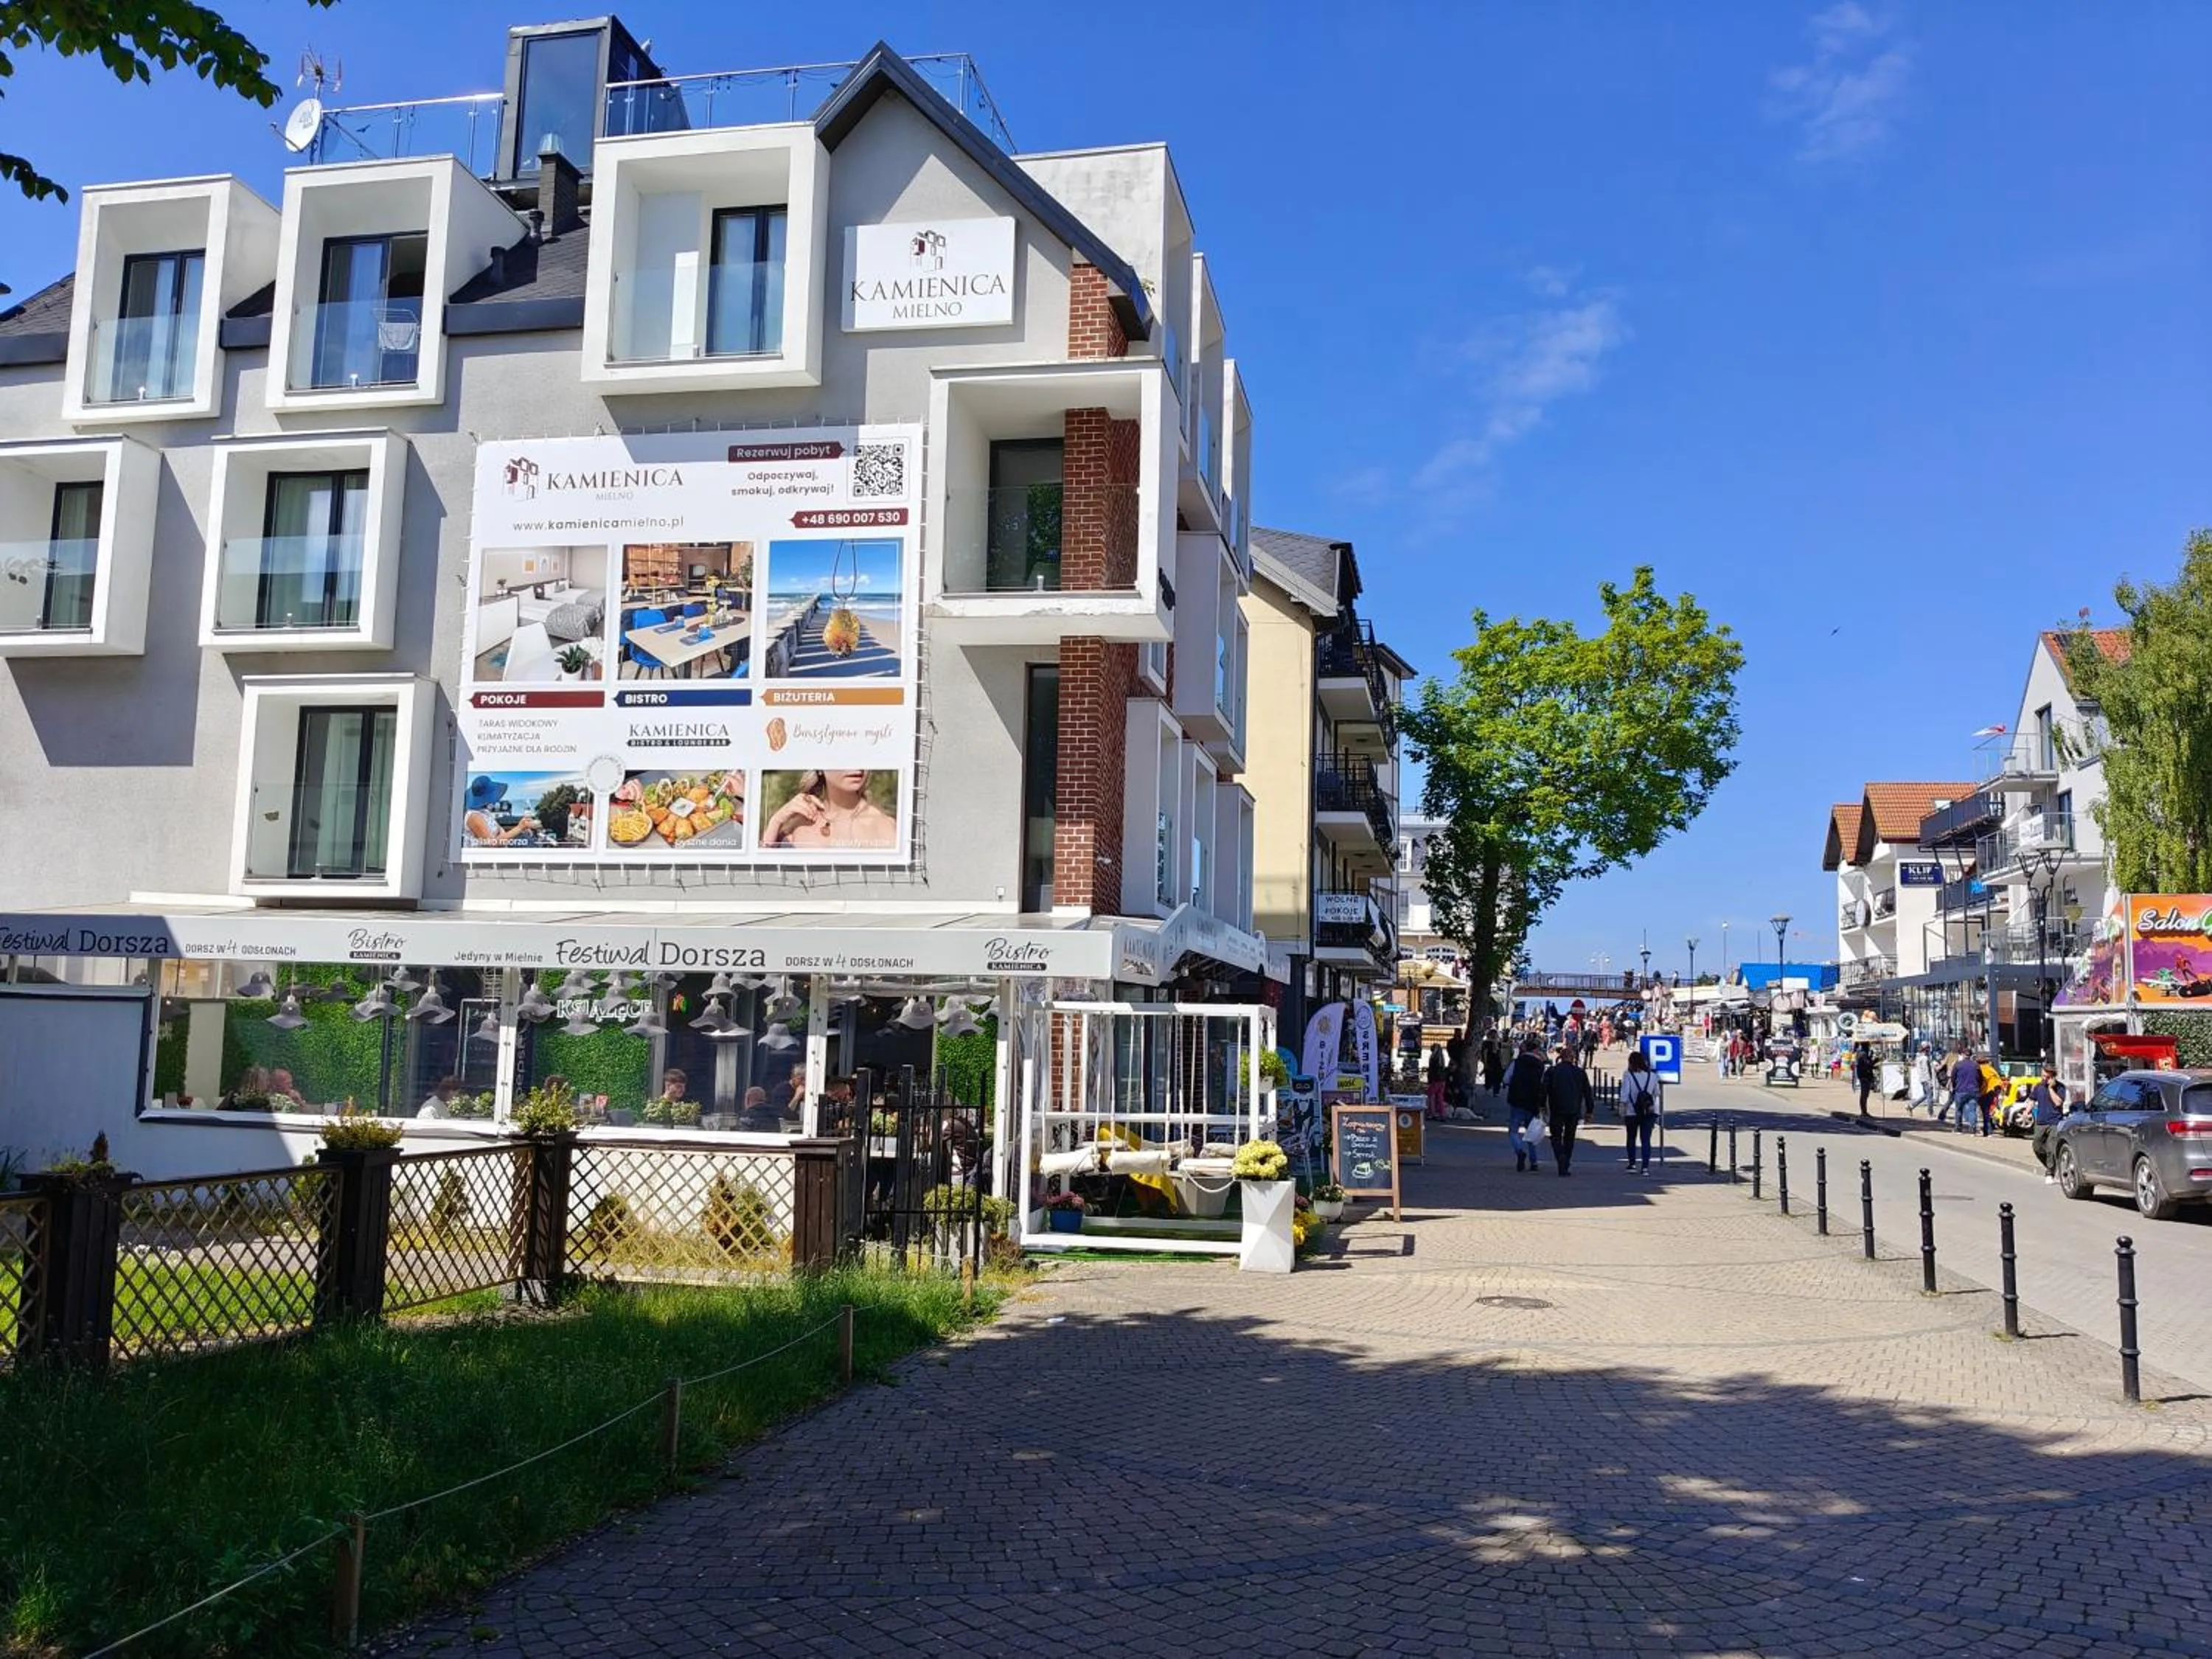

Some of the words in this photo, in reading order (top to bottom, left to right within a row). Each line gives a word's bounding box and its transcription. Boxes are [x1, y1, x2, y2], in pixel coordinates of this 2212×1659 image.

[850, 274, 1006, 302] KAMIENICA
[893, 301, 962, 319] MIELNO
[737, 448, 791, 459] Rezerwuj
[794, 445, 831, 458] pobyt
[548, 468, 684, 490] KAMIENICA
[748, 470, 818, 482] Odpoczywaj,
[595, 492, 633, 501] MIELNO
[731, 486, 775, 497] smokuj,
[778, 484, 834, 496] odkrywaj!
[513, 515, 684, 531] www.kamienicamielno.pl
[801, 514, 824, 524] +48
[827, 513, 849, 524] 690
[852, 513, 874, 524] 007
[877, 512, 900, 523] 530
[480, 694, 527, 704] POKOJE
[625, 694, 668, 704] BISTRO
[773, 691, 835, 703] BIŻUTERIA
[479, 720, 505, 728] TARAS
[508, 720, 558, 728] WIDOKOWY
[630, 723, 730, 737] KAMIENICA
[478, 732, 540, 740] KLIMATYZACJA
[526, 745, 542, 753] DLA
[708, 837, 737, 846] dania
[2138, 908, 2199, 933] Salon
[79, 929, 169, 953] Dorsza
[348, 928, 406, 950] Bistro
[184, 945, 214, 954] DORSZ
[216, 944, 225, 954] W
[241, 945, 296, 956] ODSŁONACH
[555, 939, 650, 967] Festiwal
[659, 942, 766, 967] Dorsza
[984, 937, 1053, 960] Bistro
[453, 950, 492, 961] Jedyny
[505, 951, 543, 962] Mielnie
[785, 956, 820, 967] DORSZ
[823, 956, 833, 967] W
[850, 957, 914, 968] ODSŁONACH
[991, 962, 1042, 970] KAMIENICA
[1649, 1039, 1673, 1070] P
